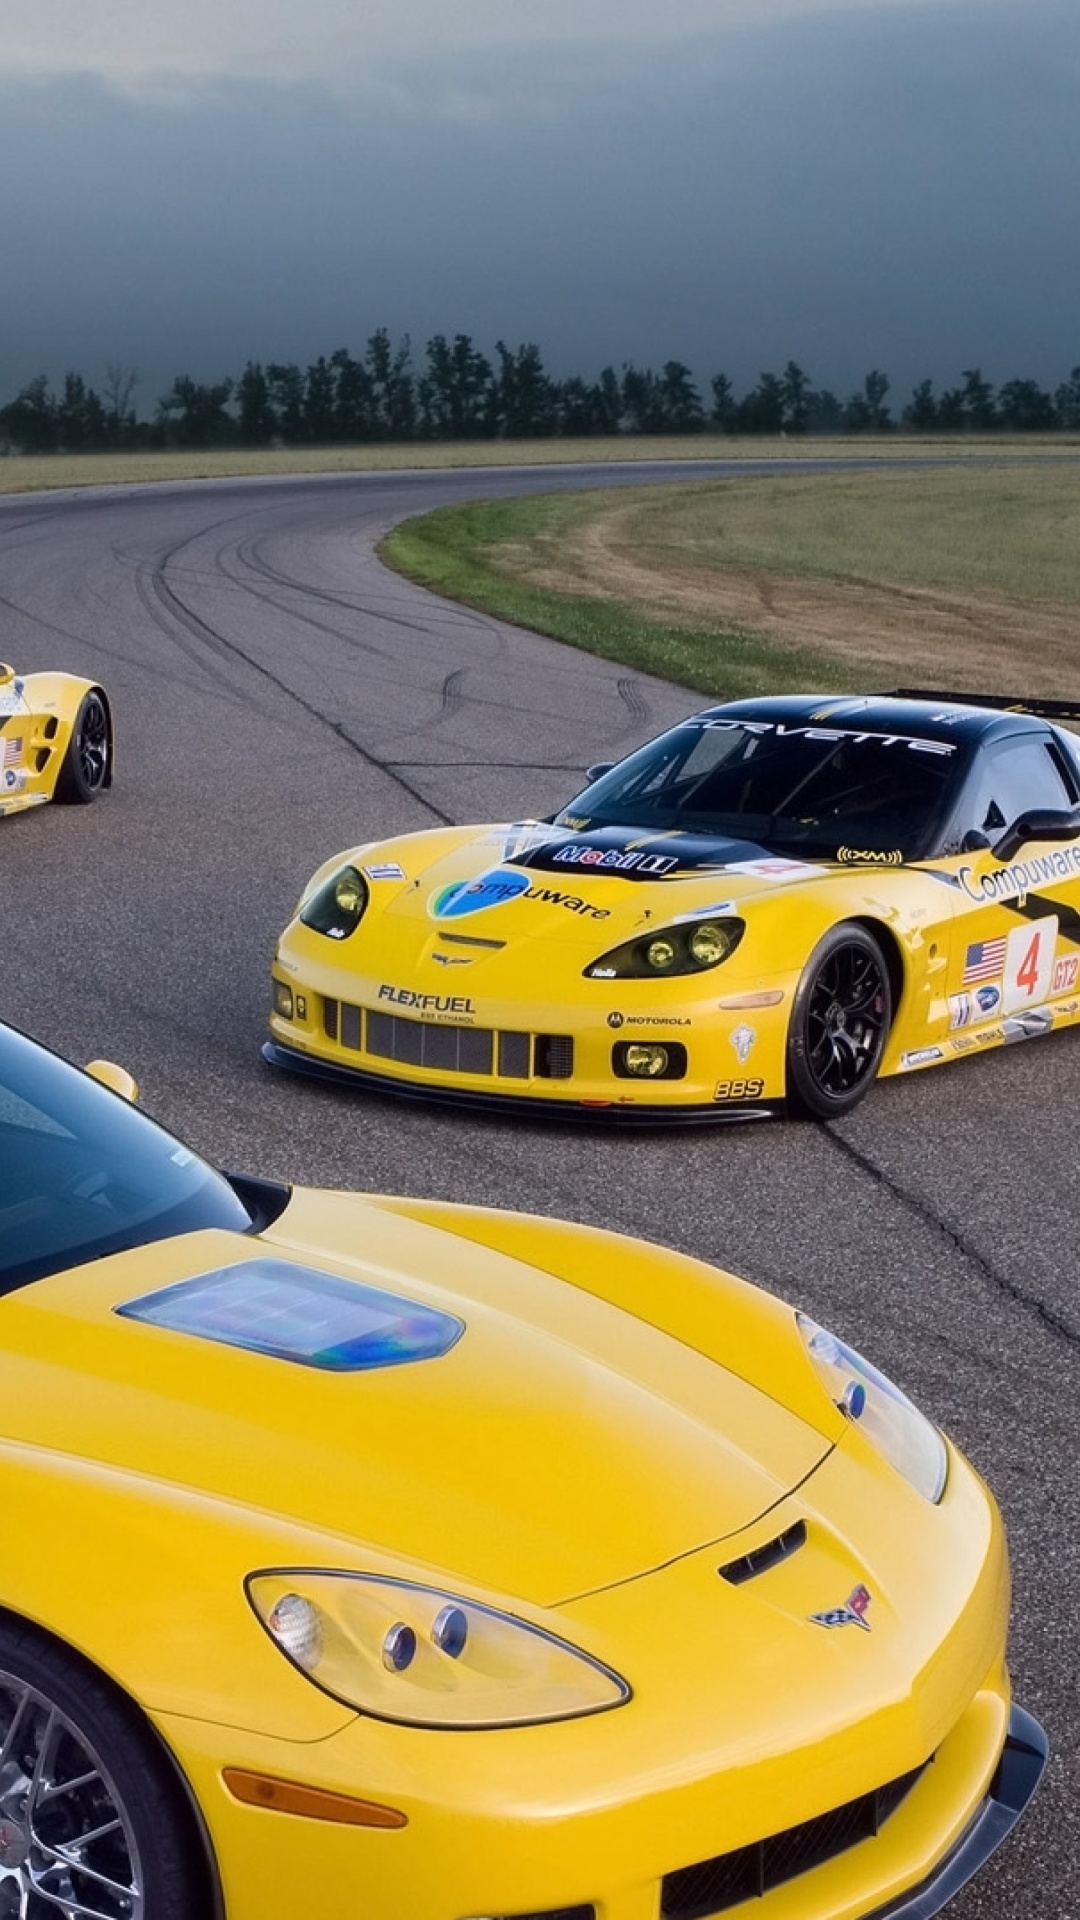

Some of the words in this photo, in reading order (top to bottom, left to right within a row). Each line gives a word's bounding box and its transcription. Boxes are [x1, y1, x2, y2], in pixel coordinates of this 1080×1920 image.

[680, 718, 957, 757] CORVETTE
[553, 845, 645, 869] Mobil
[959, 846, 1080, 903] Compuware
[450, 881, 611, 920] ompuware
[1016, 931, 1041, 996] 4
[1053, 957, 1079, 990] GT2
[378, 984, 476, 1015] FLEXFUEL
[625, 1016, 692, 1026] MOTOROLA
[713, 1078, 764, 1102] BBS
